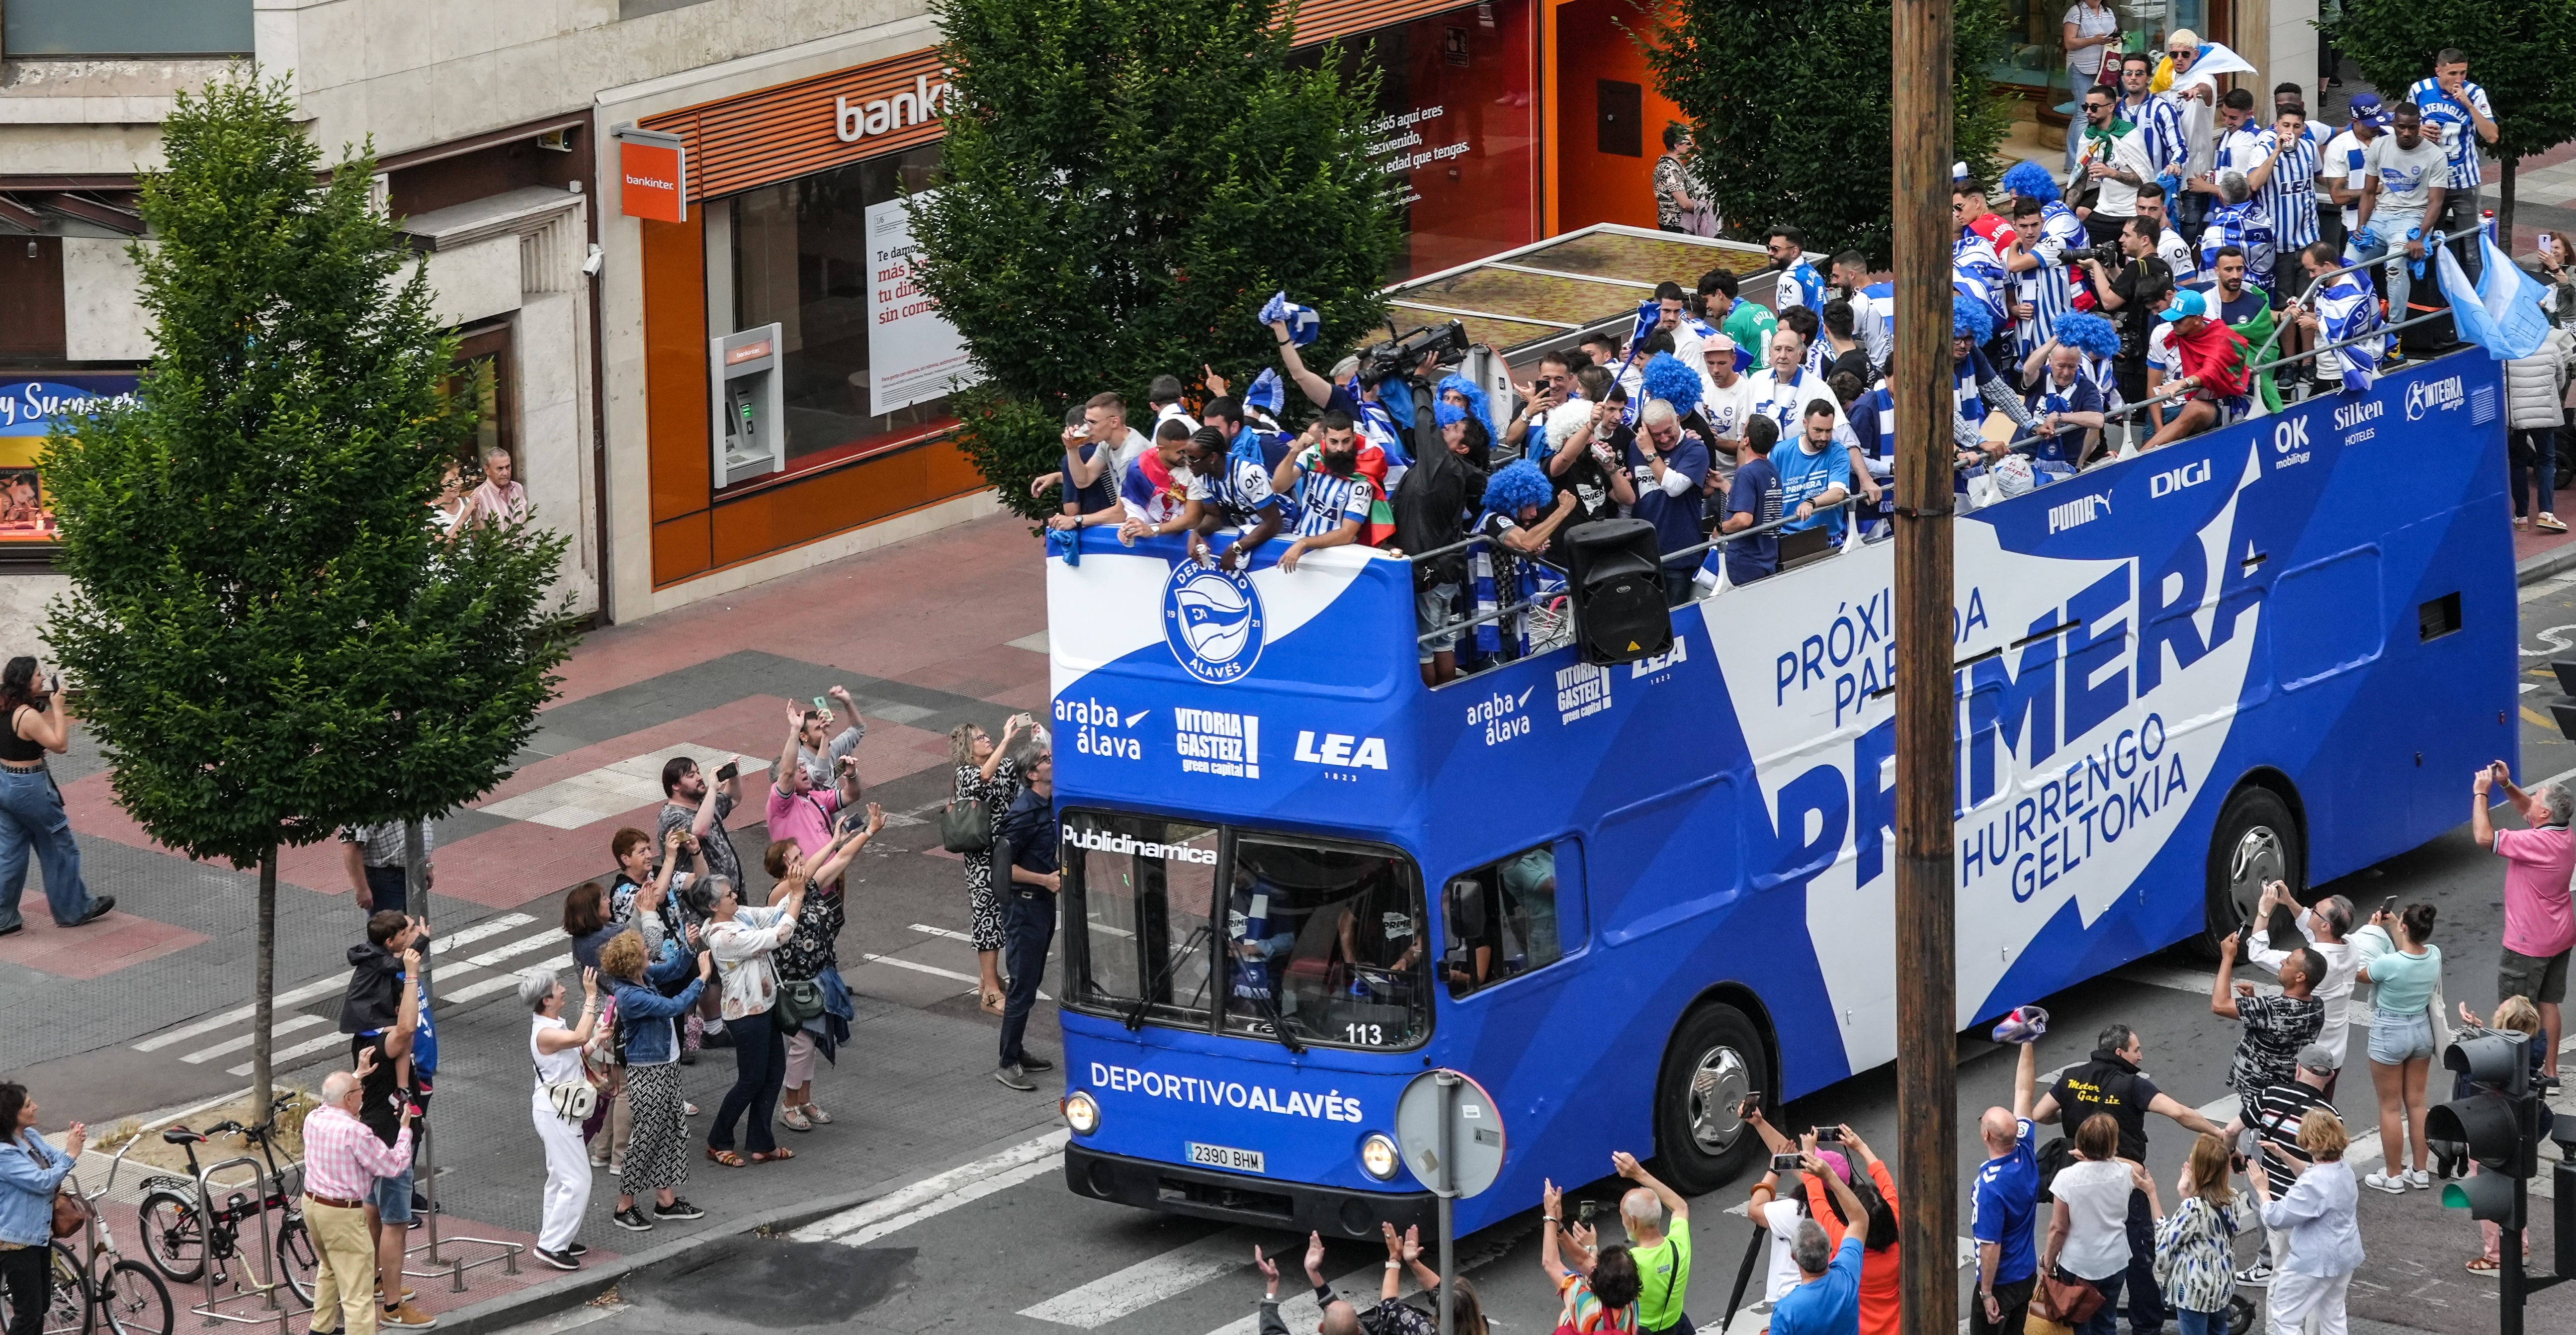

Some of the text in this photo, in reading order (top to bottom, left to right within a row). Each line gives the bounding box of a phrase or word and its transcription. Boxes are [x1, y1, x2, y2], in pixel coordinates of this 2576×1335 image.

[836, 68, 963, 142] banki
[1397, 107, 1420, 129] aquí
[1421, 105, 1443, 120] eres
[1386, 153, 1412, 173] edad
[1413, 151, 1432, 169] que
[1433, 141, 1470, 160] tengas.
[2280, 178, 2312, 196] LEA
[877, 251, 888, 262] Te
[2174, 247, 2189, 259] OK
[878, 263, 905, 282] más
[878, 289, 892, 303] tu
[879, 307, 899, 324] sin
[2425, 375, 2464, 408] INTEGRA
[2334, 400, 2384, 431] Silken
[2275, 415, 2310, 453] OK
[2345, 428, 2375, 446] HOTELES
[1245, 470, 1262, 489] OK
[1355, 485, 1372, 497] OK
[1786, 480, 1822, 494] PRIMERA
[2150, 458, 2212, 499] DIGI
[1307, 493, 1338, 521] LEA
[2049, 495, 2096, 535] PUMA
[1166, 610, 1177, 619] 19
[1777, 587, 1889, 708] PRÓXI
[1189, 658, 1241, 678] ALAVÉS
[1467, 692, 1514, 726] araba
[1557, 679, 1601, 712] GASTEIZ
[1054, 697, 1118, 729] araba
[1174, 707, 1243, 738] VITORIA
[1562, 700, 1602, 725] green capital
[1778, 527, 2263, 895] PRMERA
[1076, 724, 1141, 760] álava
[1486, 715, 1530, 746] álava
[1176, 732, 1243, 762] GASTEIZ
[1293, 730, 1388, 771] LEA
[1182, 759, 1244, 778] green capital
[1963, 712, 2166, 889] HURRENGO
[2012, 752, 2188, 903] GELTOKIA
[1062, 824, 1218, 865] Publidinamica
[1345, 1023, 1382, 1045] 113
[2077, 1090, 2121, 1105] Gasiz
[1195, 1146, 1259, 1169] 2390 BHM
